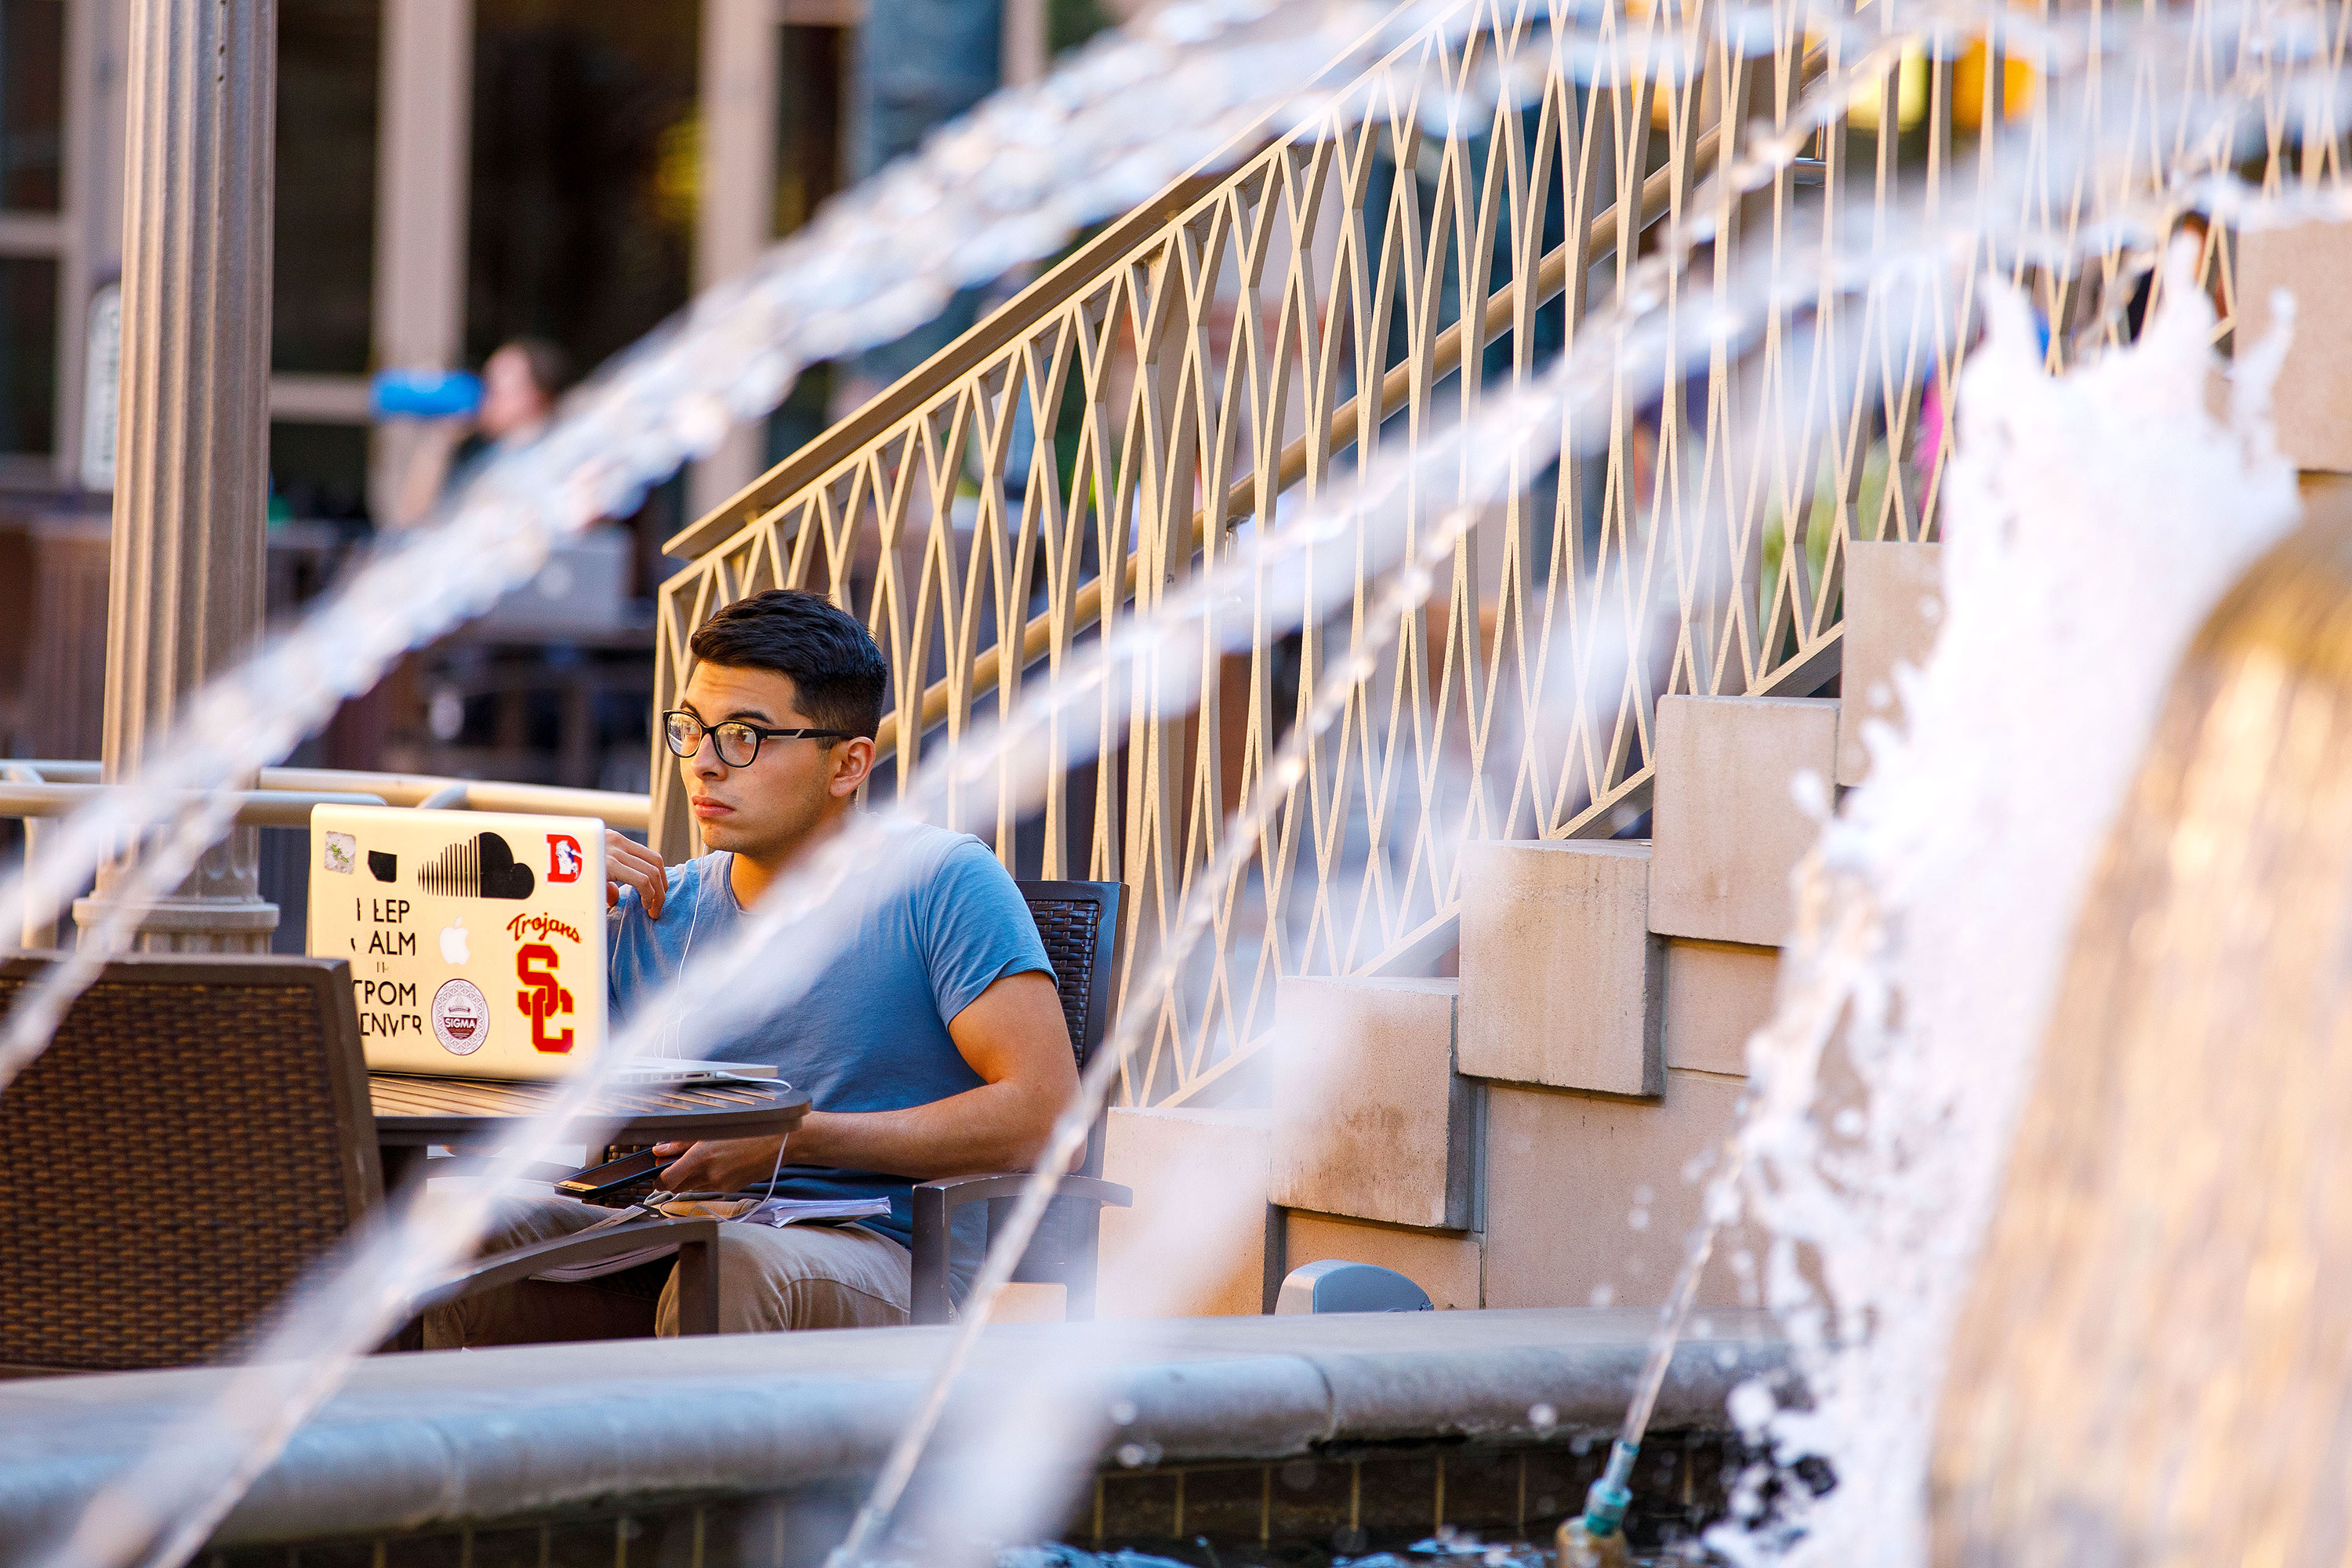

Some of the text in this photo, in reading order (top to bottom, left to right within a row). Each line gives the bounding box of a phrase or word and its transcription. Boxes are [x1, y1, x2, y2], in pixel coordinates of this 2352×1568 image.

[506, 913, 583, 944] Trojans
[350, 930, 416, 956] ALM
[516, 942, 575, 1055] SC
[445, 1018, 476, 1029] SIGMA
